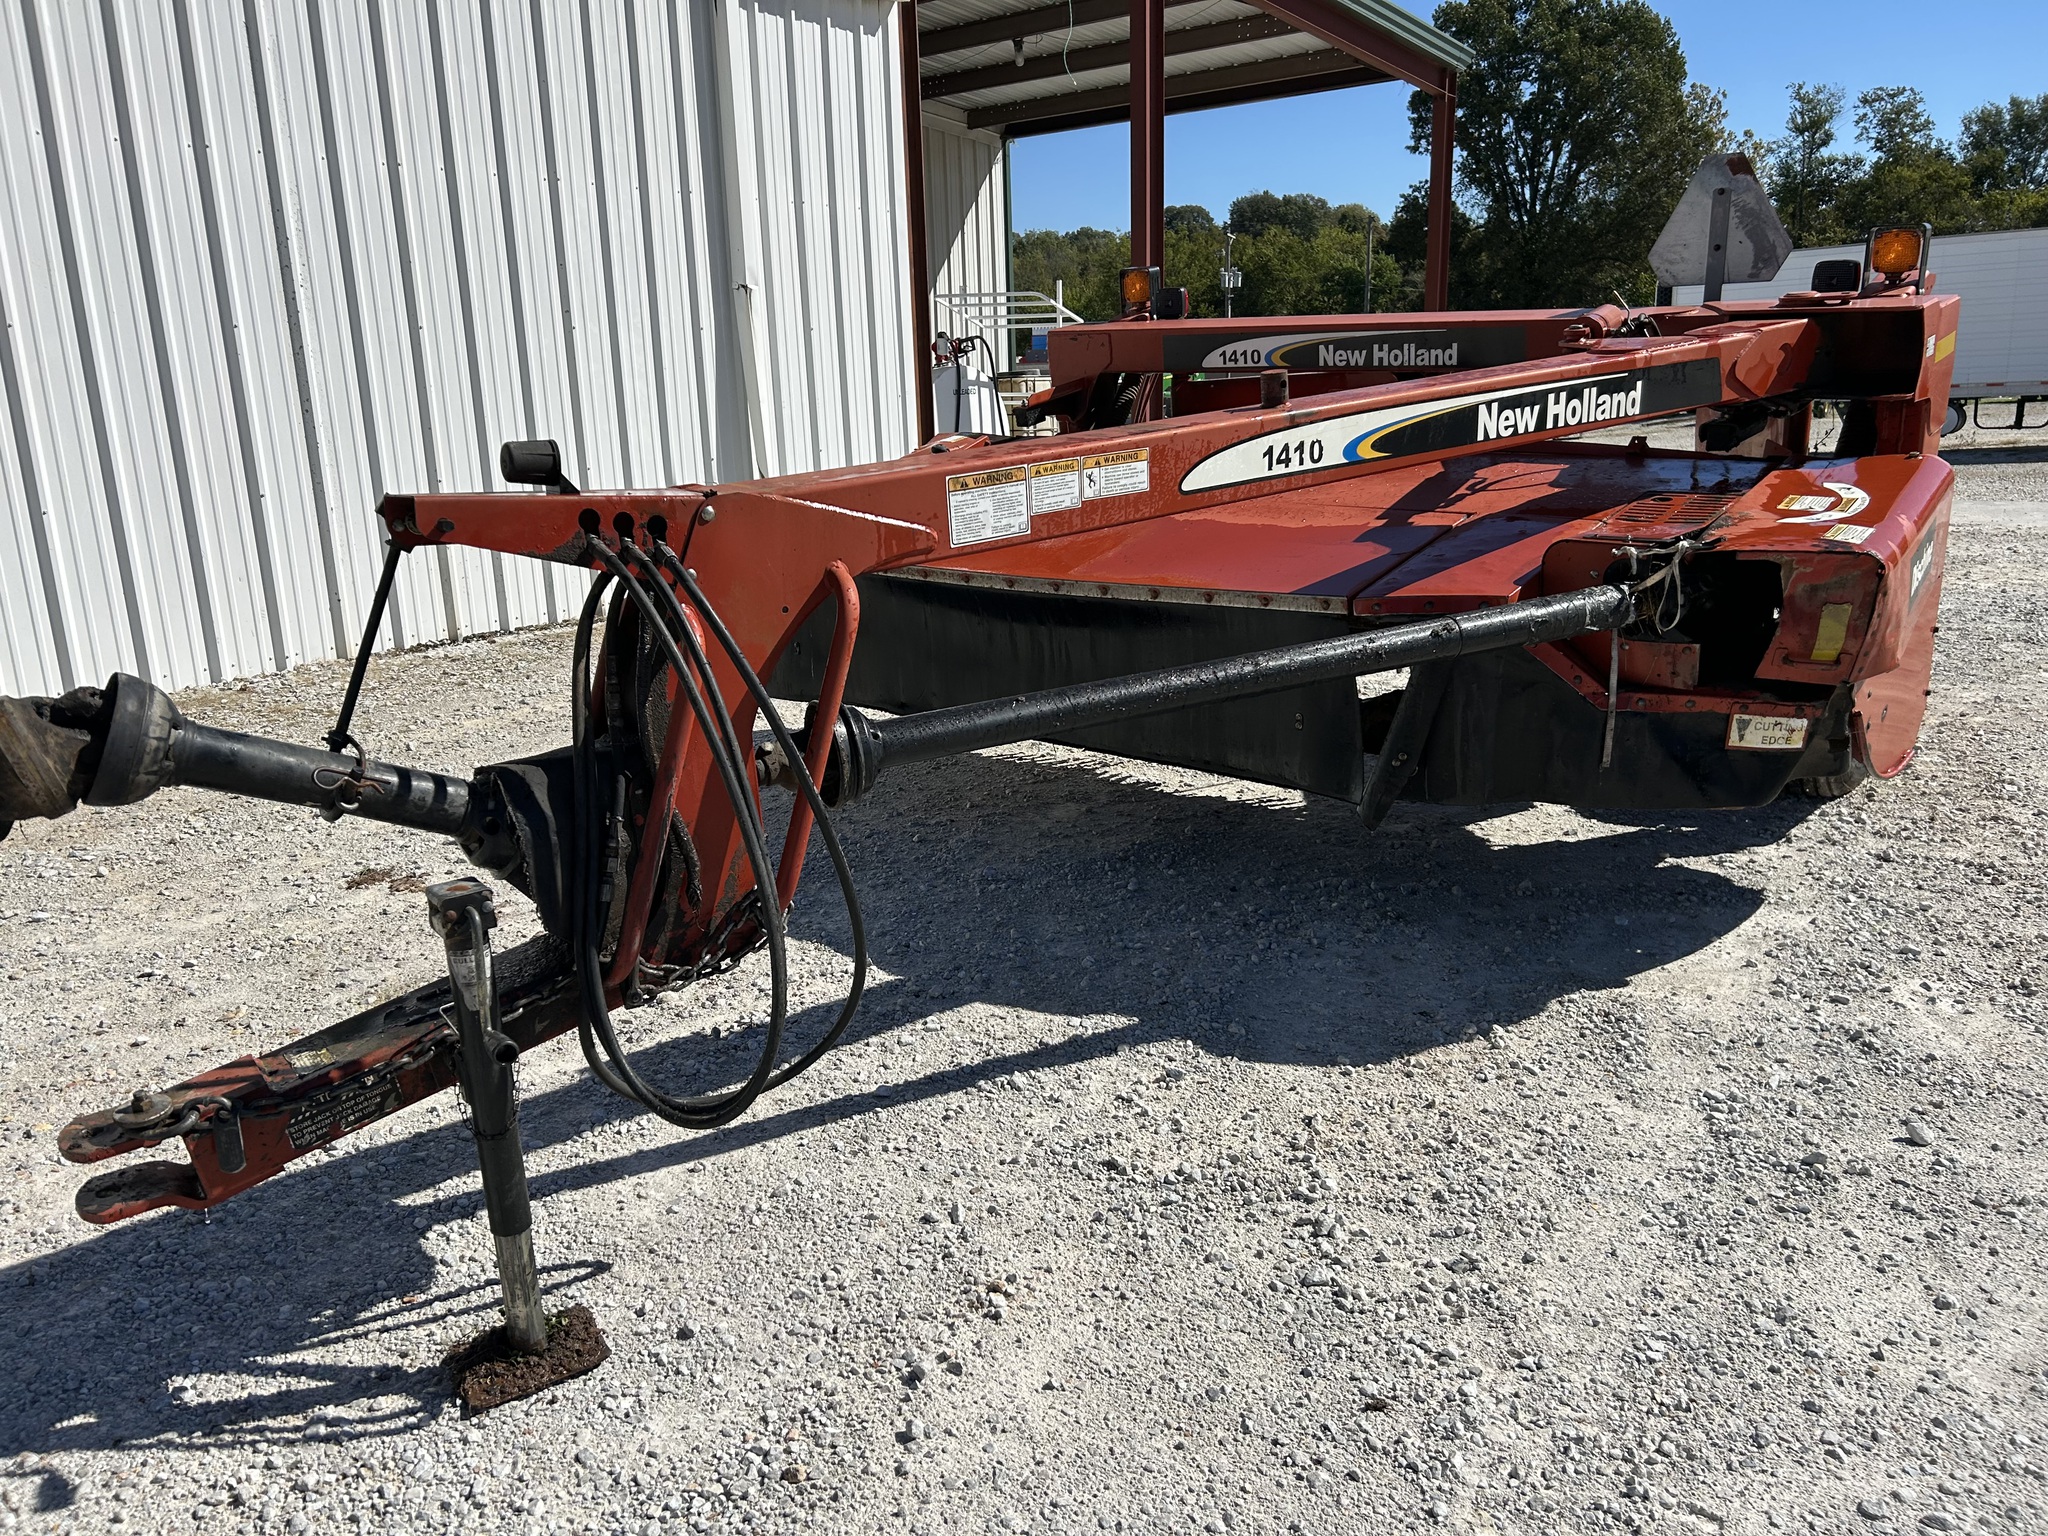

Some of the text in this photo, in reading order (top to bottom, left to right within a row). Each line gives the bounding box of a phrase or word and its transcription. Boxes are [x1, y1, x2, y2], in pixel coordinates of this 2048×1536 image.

[1218, 343, 1458, 366] 1410 New Holland
[1262, 381, 1643, 470] 1410 New Holland
[1103, 453, 1139, 464] WARNING
[1042, 462, 1074, 474] WARNING
[972, 472, 1014, 486] WARNING
[290, 1120, 313, 1132] STORE
[313, 1112, 331, 1122] JACK
[367, 1085, 392, 1098] TONGUE
[303, 1118, 335, 1133] PREVENT
[335, 1109, 353, 1119] JCK
[354, 1096, 382, 1110] DAMAGE
[295, 1133, 316, 1145] WN
